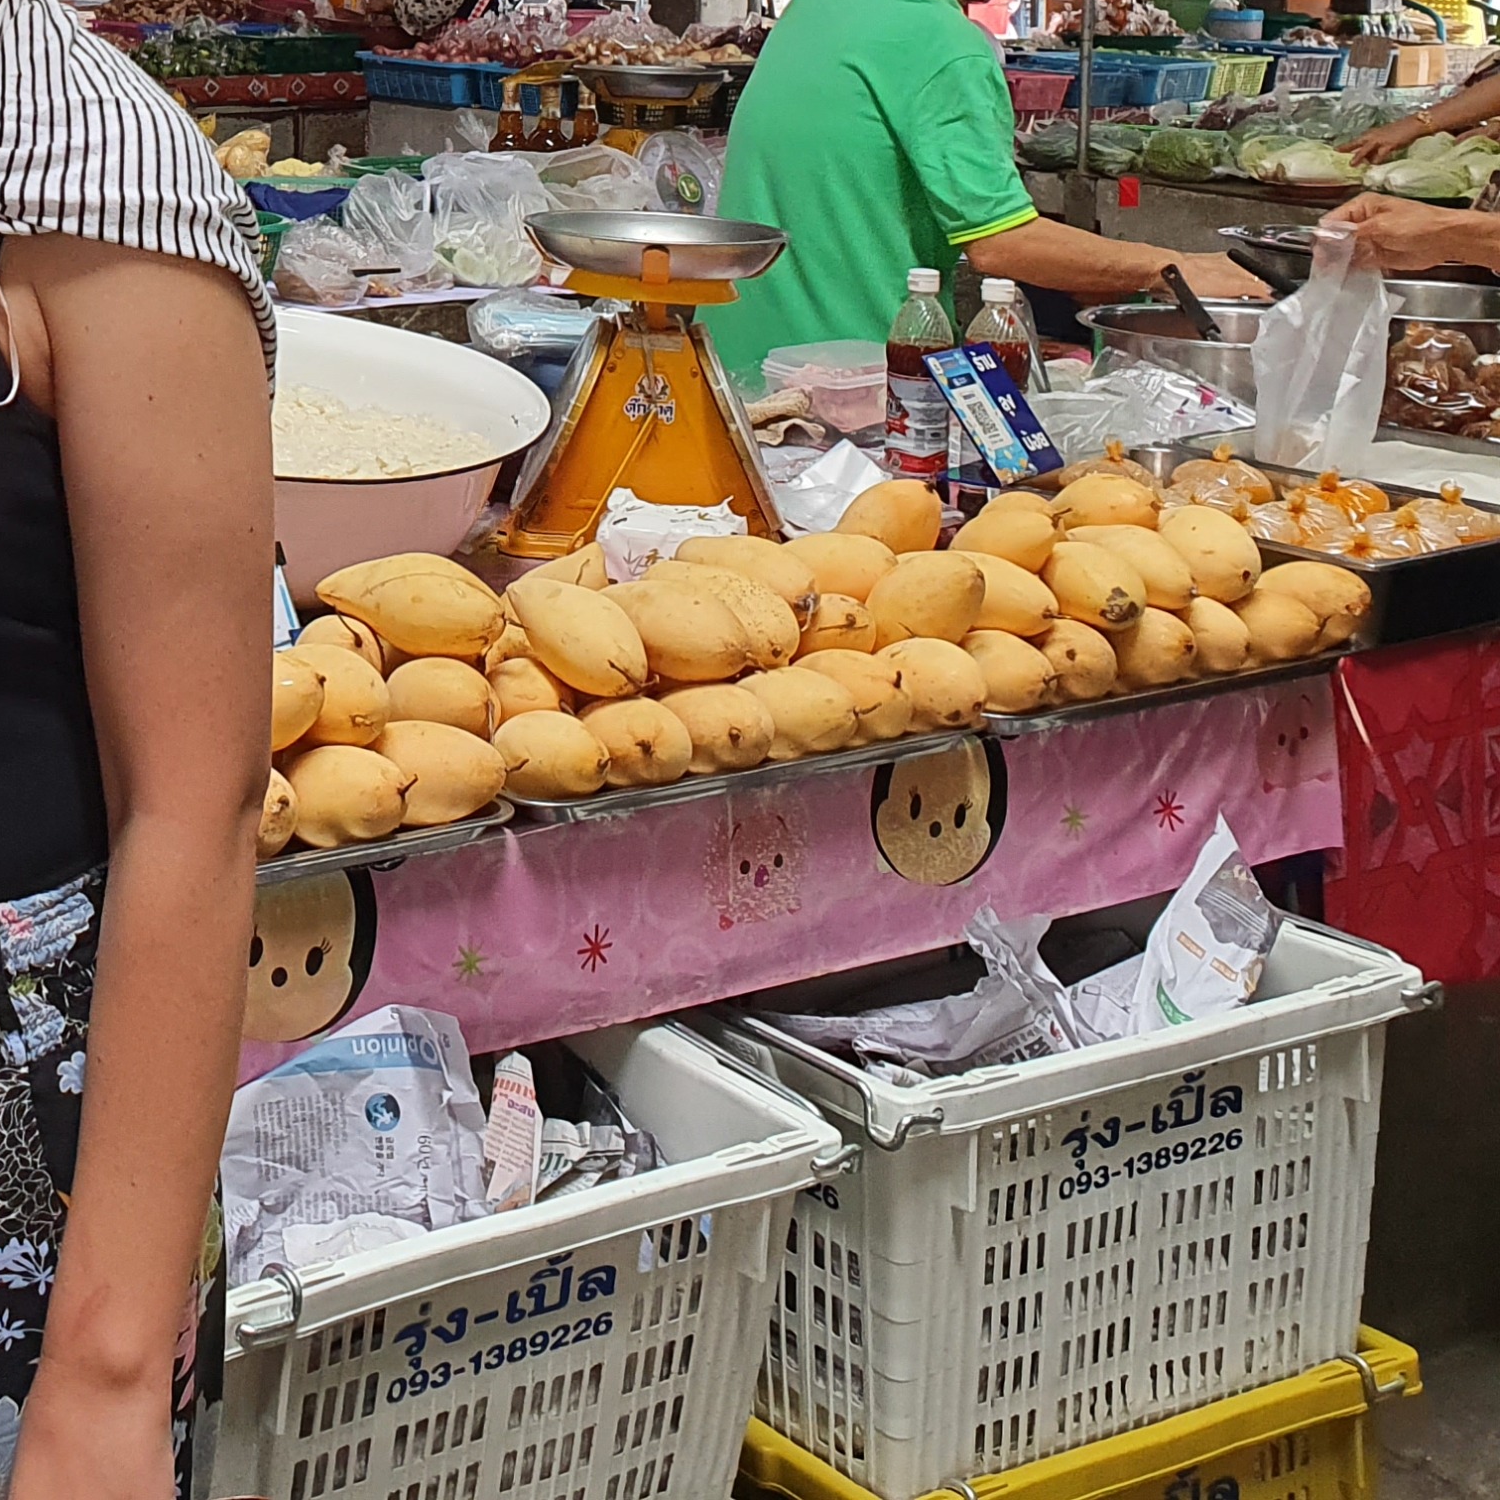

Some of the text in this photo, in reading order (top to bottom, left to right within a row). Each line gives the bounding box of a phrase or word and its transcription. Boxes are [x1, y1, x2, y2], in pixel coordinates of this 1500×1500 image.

[625, 398, 673, 423] ตุ๊กาคู่
[352, 1037, 438, 1066] Opinion
[1059, 1128, 1243, 1200] 093-1389226
[386, 1311, 613, 1403] 093-1389226
